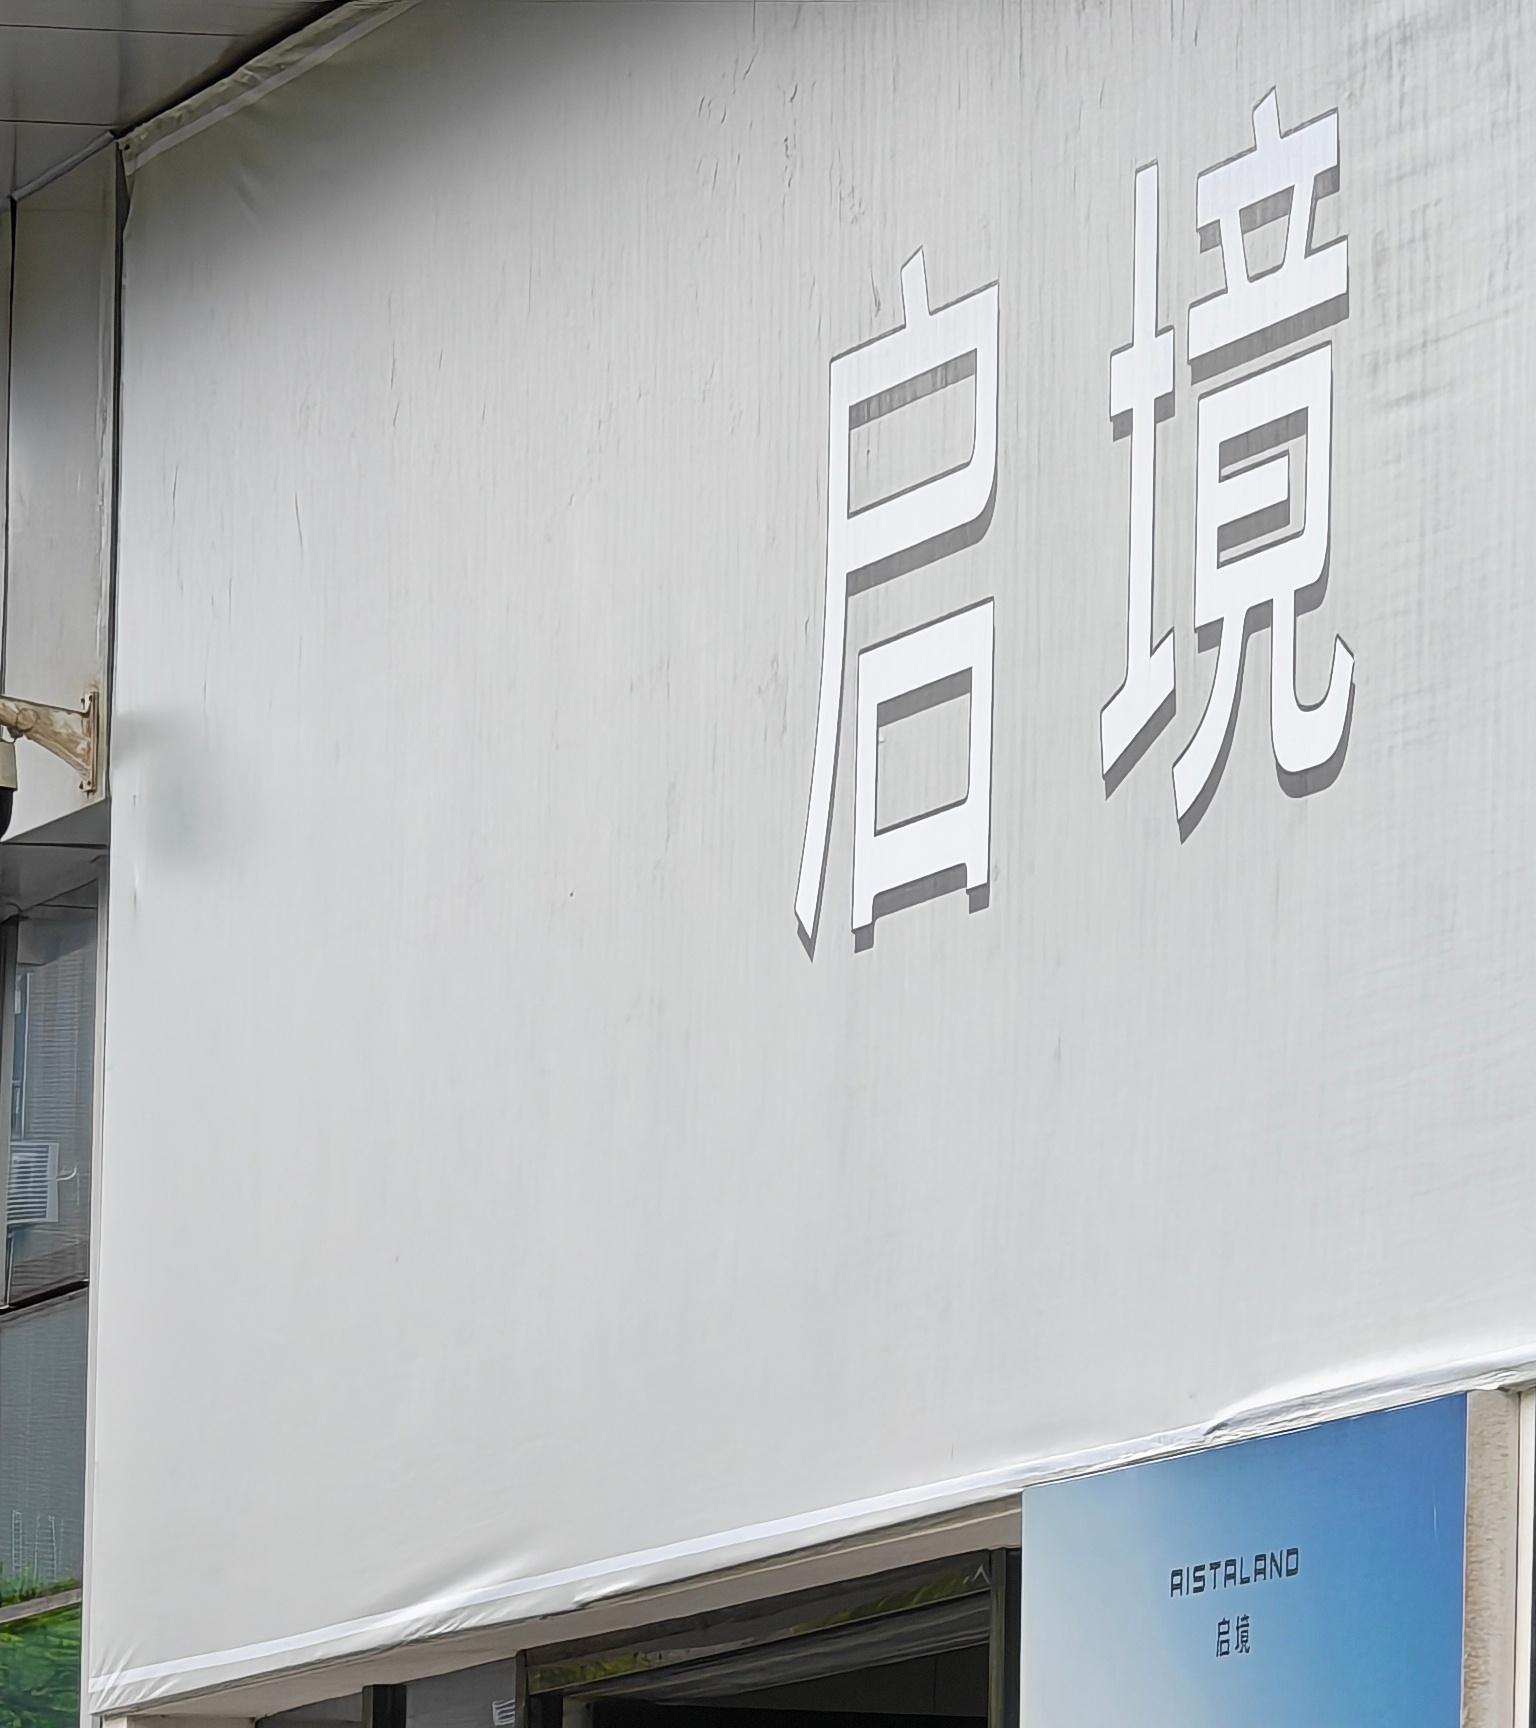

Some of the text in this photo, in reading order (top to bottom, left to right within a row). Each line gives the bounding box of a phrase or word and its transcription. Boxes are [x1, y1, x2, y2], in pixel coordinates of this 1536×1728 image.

[794, 86, 1355, 941] 启境
[1170, 1547, 1299, 1597] AISTALAND
[1216, 1613, 1251, 1657] 启境
